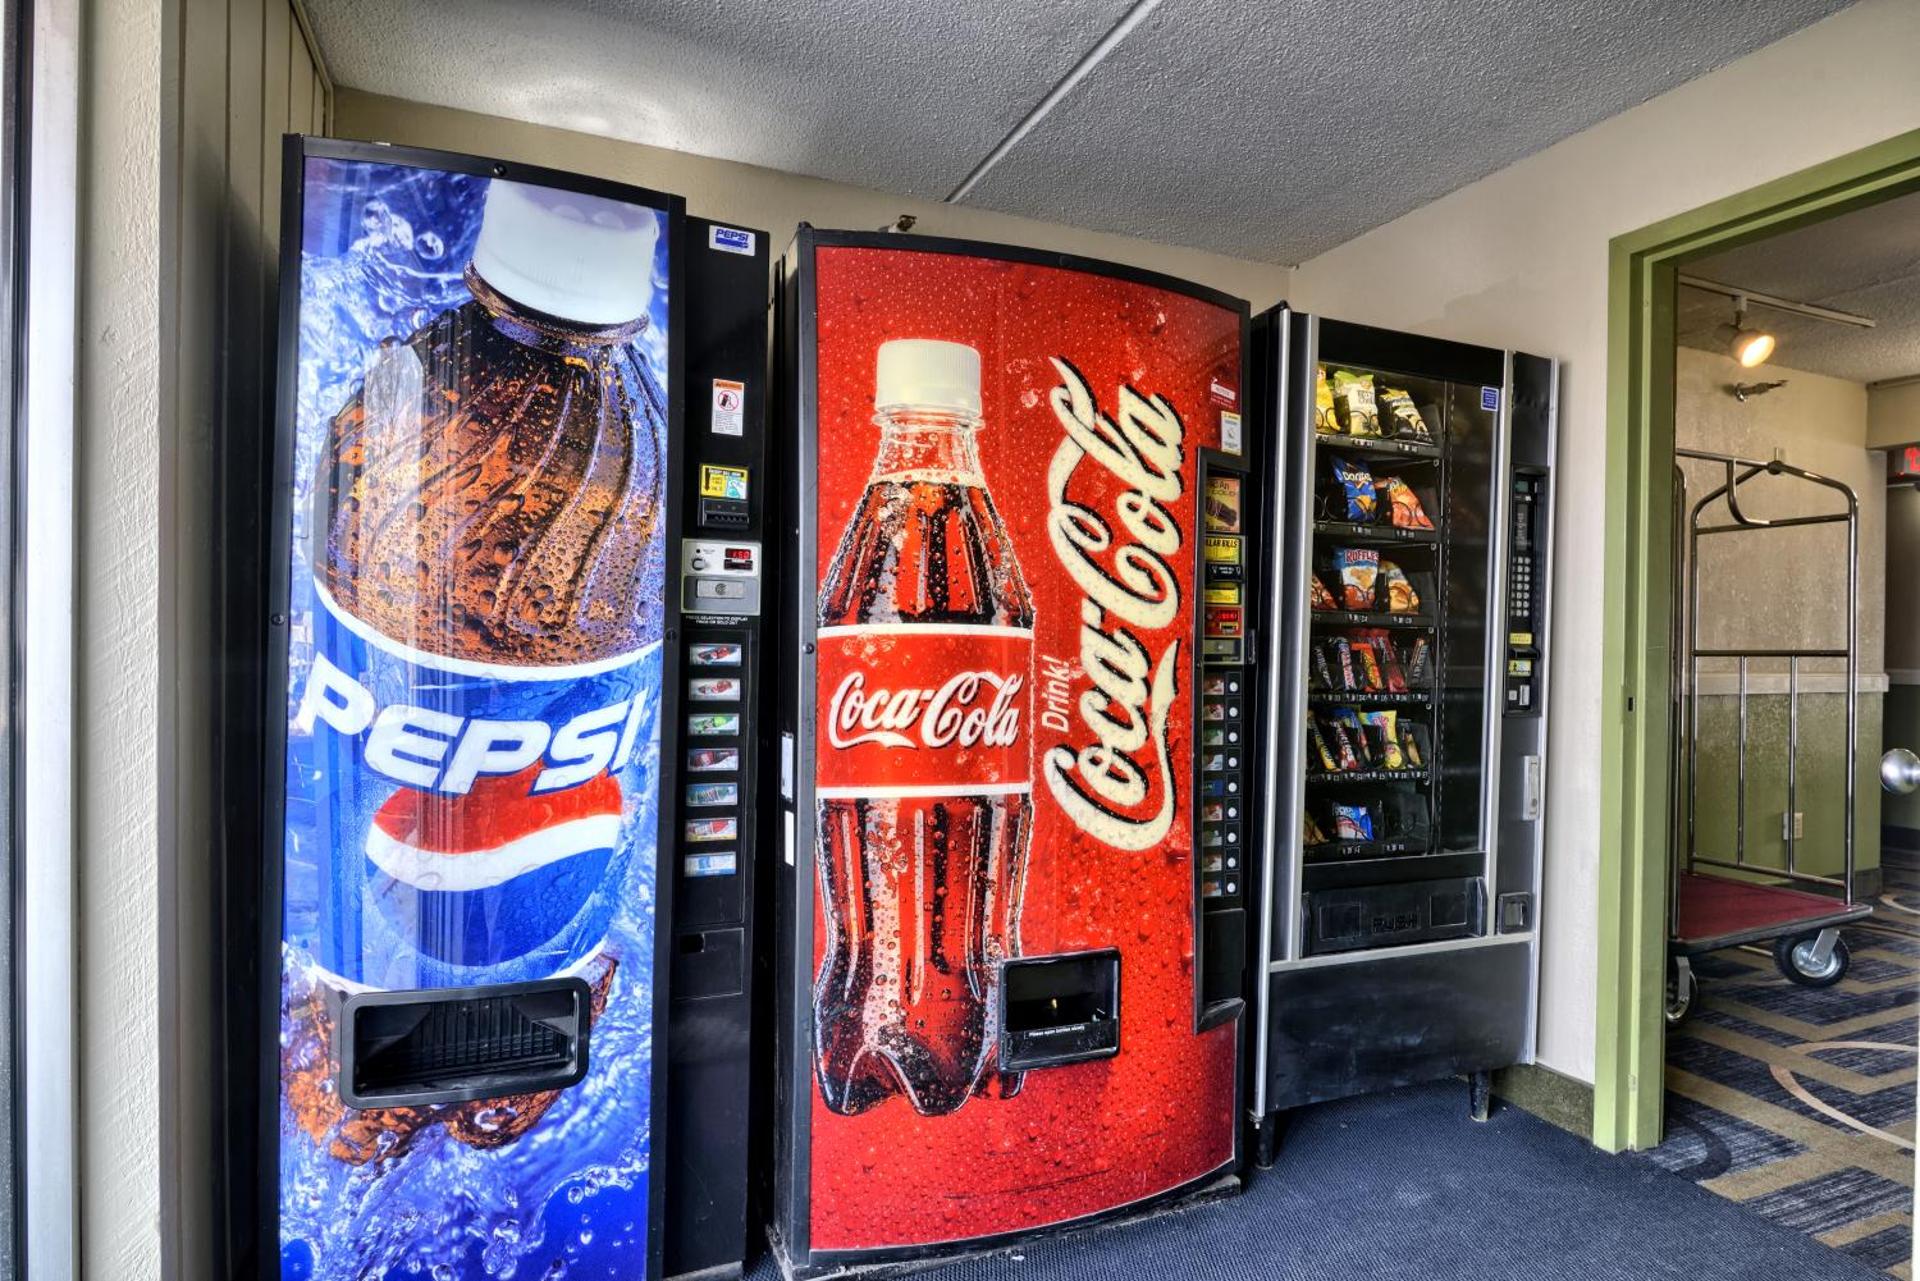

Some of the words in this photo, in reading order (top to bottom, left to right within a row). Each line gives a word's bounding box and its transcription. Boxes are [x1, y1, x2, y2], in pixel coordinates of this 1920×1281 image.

[715, 228, 749, 242] PEPSI
[1344, 549, 1379, 564] RUFFLES
[1043, 356, 1186, 852] Coca-Cola
[298, 650, 648, 796] PEPSI
[828, 671, 1025, 750] Coca-Cola
[1041, 654, 1070, 734] Drink!
